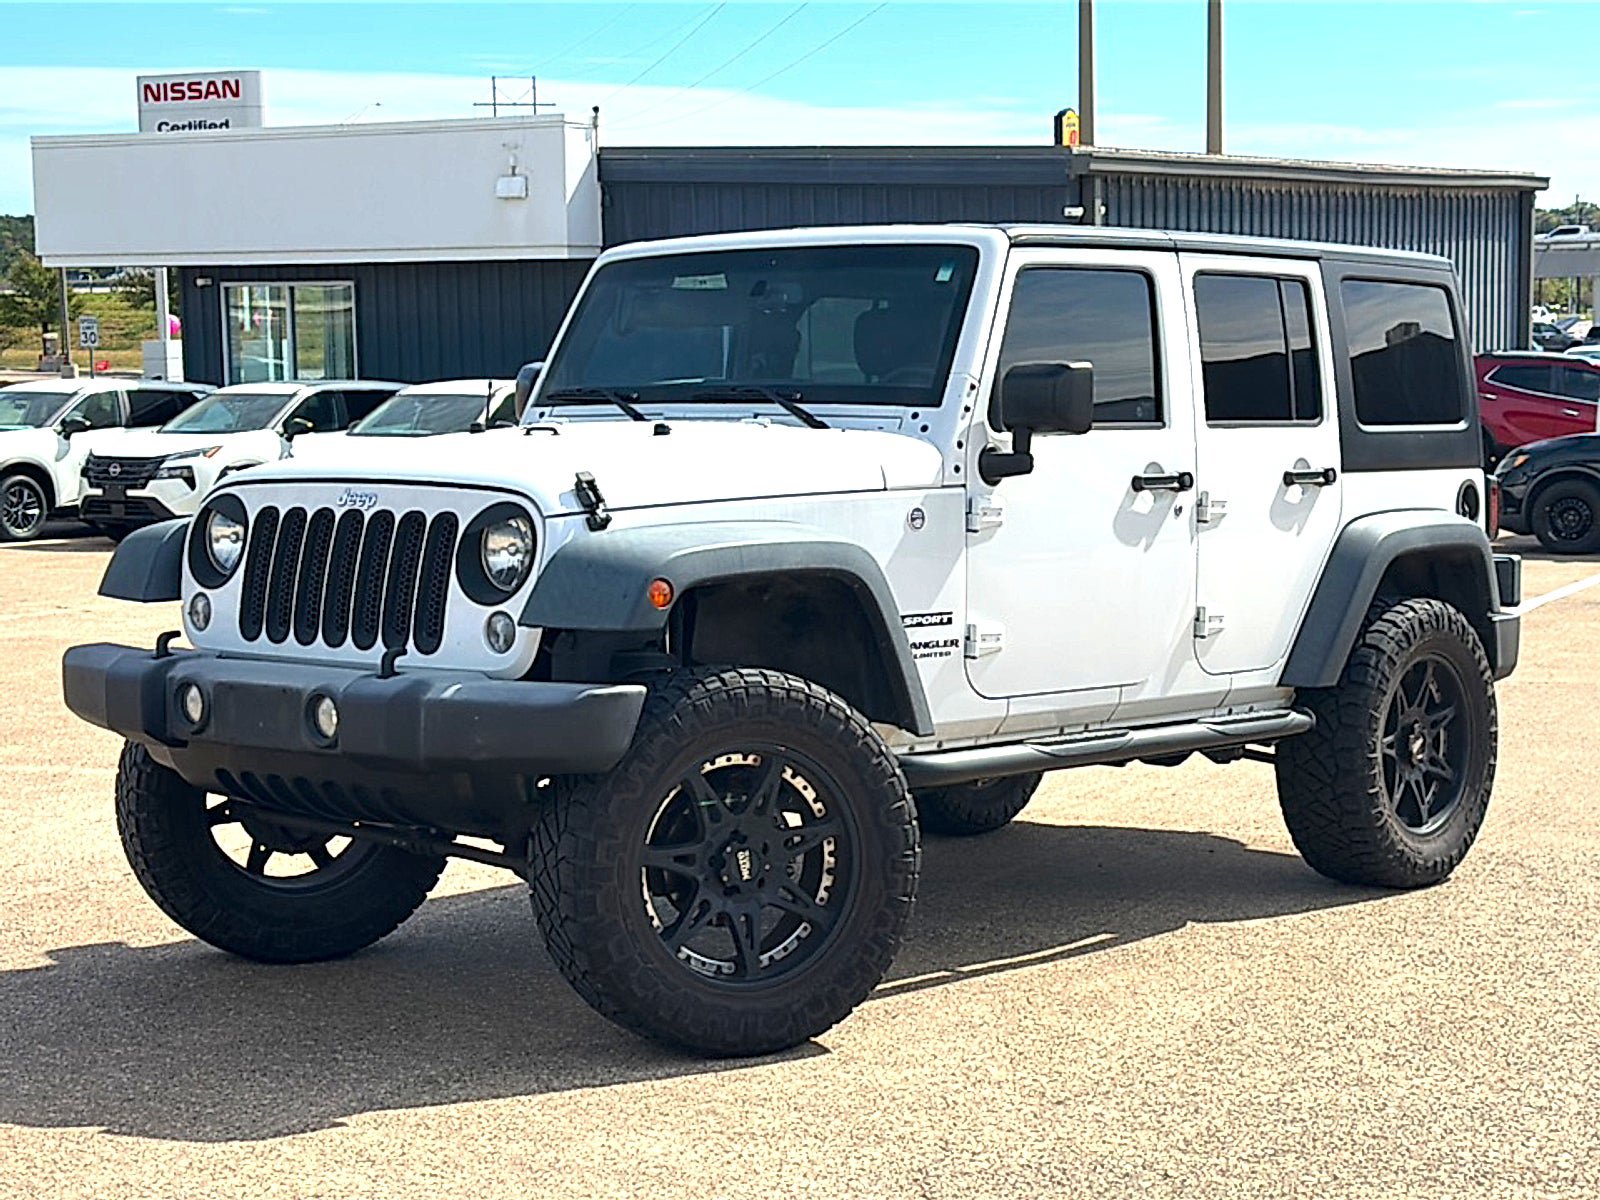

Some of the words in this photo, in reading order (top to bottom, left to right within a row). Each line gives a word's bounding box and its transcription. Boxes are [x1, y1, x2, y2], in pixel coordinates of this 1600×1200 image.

[143, 79, 240, 103] NISSAN
[157, 119, 230, 132] Certified
[82, 332, 96, 344] 30
[337, 488, 378, 511] Jeep
[903, 615, 949, 626] SPORT
[910, 639, 959, 649] ANGLER
